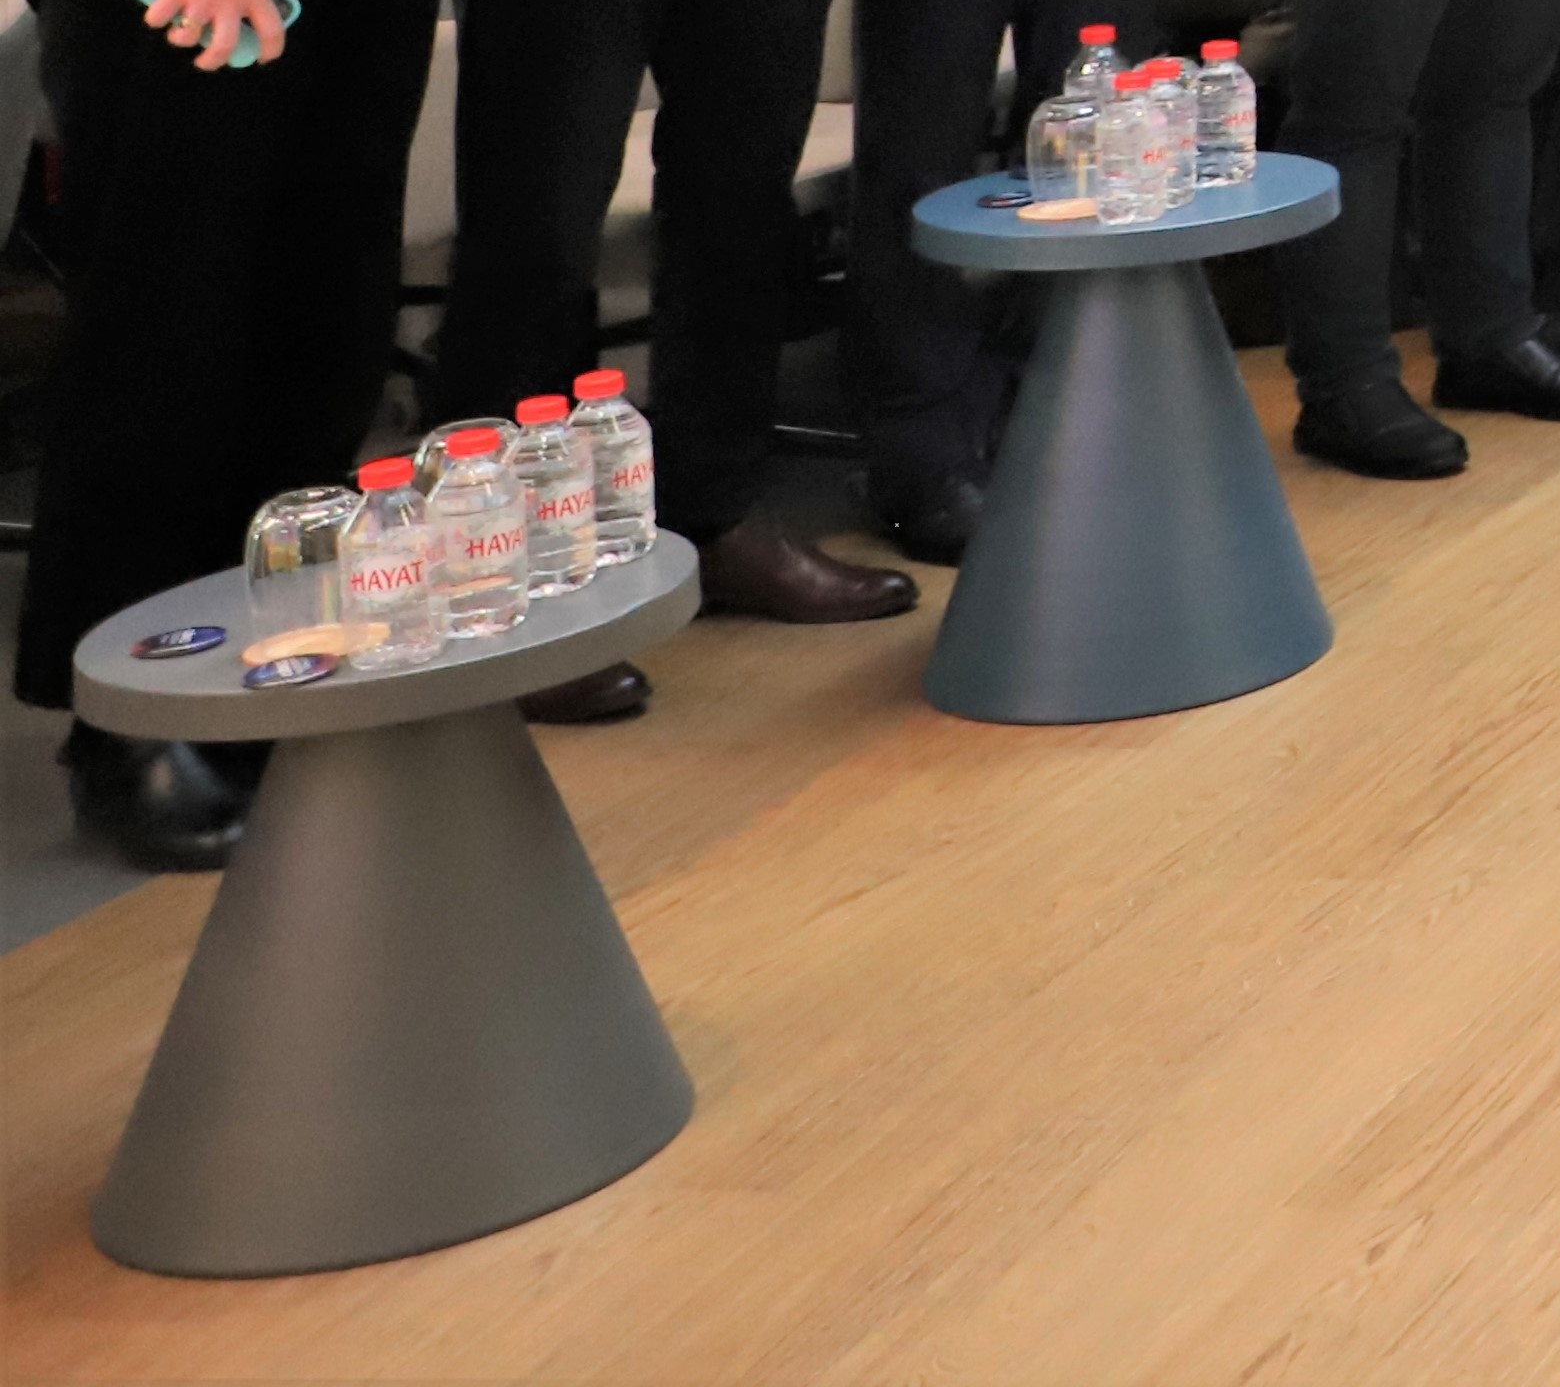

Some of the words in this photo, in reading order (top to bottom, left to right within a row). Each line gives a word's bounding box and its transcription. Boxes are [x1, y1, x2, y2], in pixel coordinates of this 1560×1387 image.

[537, 488, 594, 520] HAYA
[465, 526, 524, 559] HAYA
[351, 560, 425, 592] HAYAT
